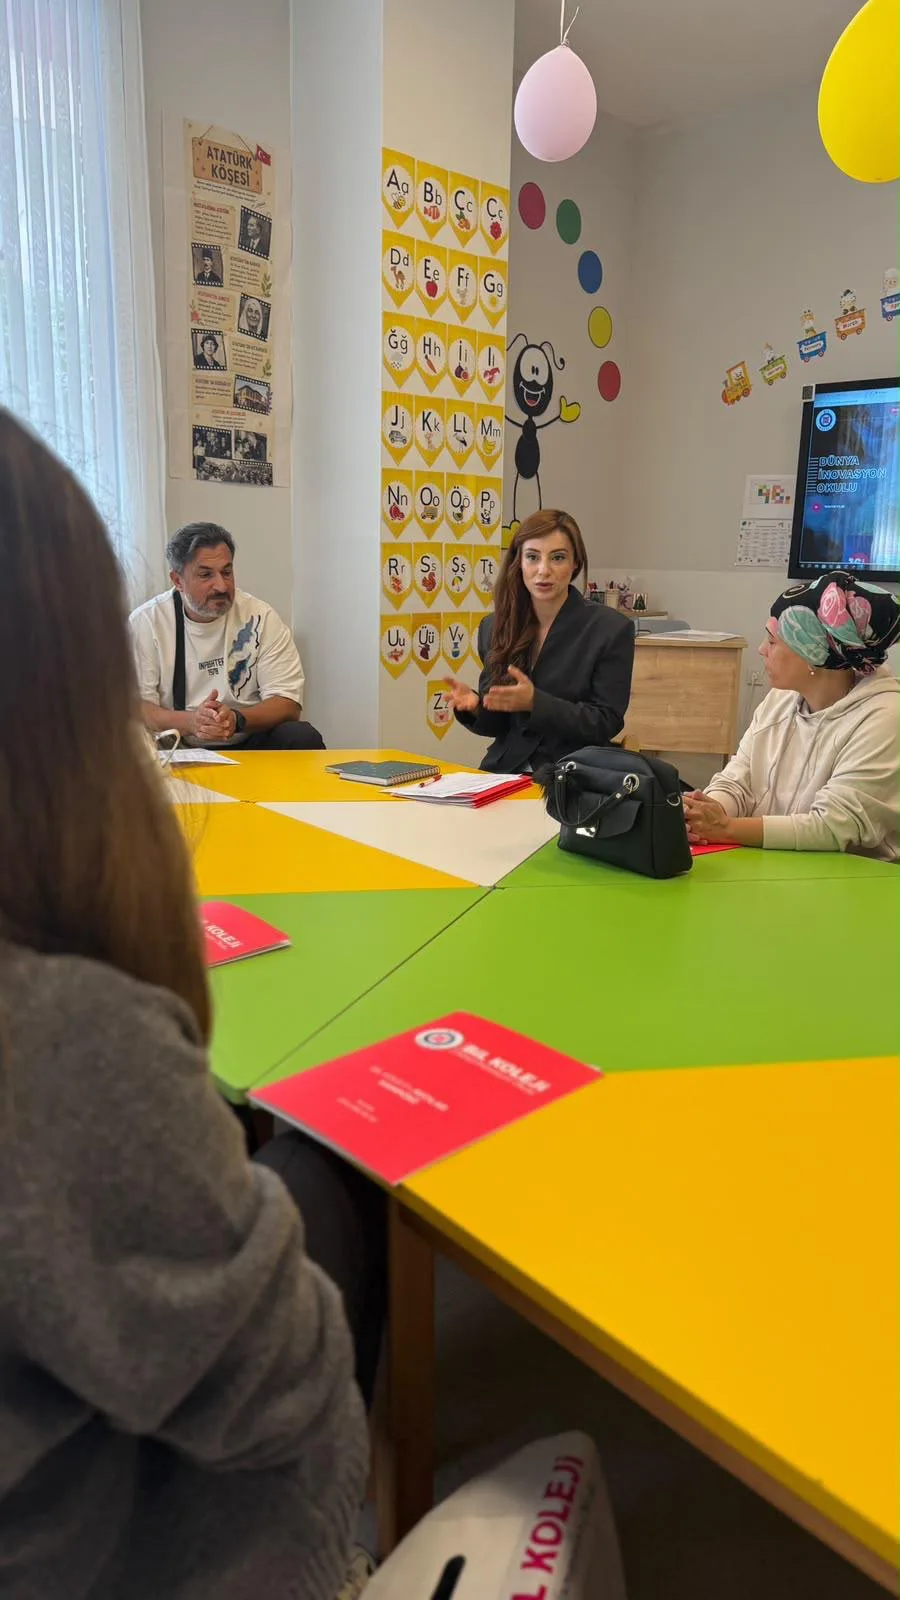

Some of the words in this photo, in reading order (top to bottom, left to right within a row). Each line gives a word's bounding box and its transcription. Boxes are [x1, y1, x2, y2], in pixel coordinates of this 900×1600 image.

[207, 146, 252, 171] ATATÜRK
[212, 164, 249, 186] KÖŞESİ
[387, 168, 409, 195] Aa
[424, 181, 442, 206] Bb
[454, 190, 473, 212] Cc
[486, 198, 504, 221] Çç
[390, 248, 409, 266] Dd
[424, 258, 440, 280] Ee
[458, 268, 470, 287] Ff
[483, 274, 504, 297] Gg
[388, 329, 408, 354] Ğğ
[423, 336, 441, 357] Hh
[391, 405, 405, 430] Jj
[422, 411, 440, 432] Kk
[454, 414, 468, 434] Ll
[481, 418, 500, 437] Mm
[819, 454, 860, 466] DÜNYA
[818, 468, 887, 480] İNOVASYON
[388, 485, 408, 506] Nn
[420, 486, 440, 506] Oo
[450, 486, 470, 508] Öö
[816, 482, 858, 493] OKULU
[481, 492, 495, 510] Pp
[388, 558, 405, 576] Rr
[420, 556, 437, 573] Ss
[452, 556, 466, 576] Şş
[480, 559, 494, 574] Tt
[388, 630, 405, 646] Uu
[418, 626, 434, 644] Üü
[448, 626, 464, 641] Vv
